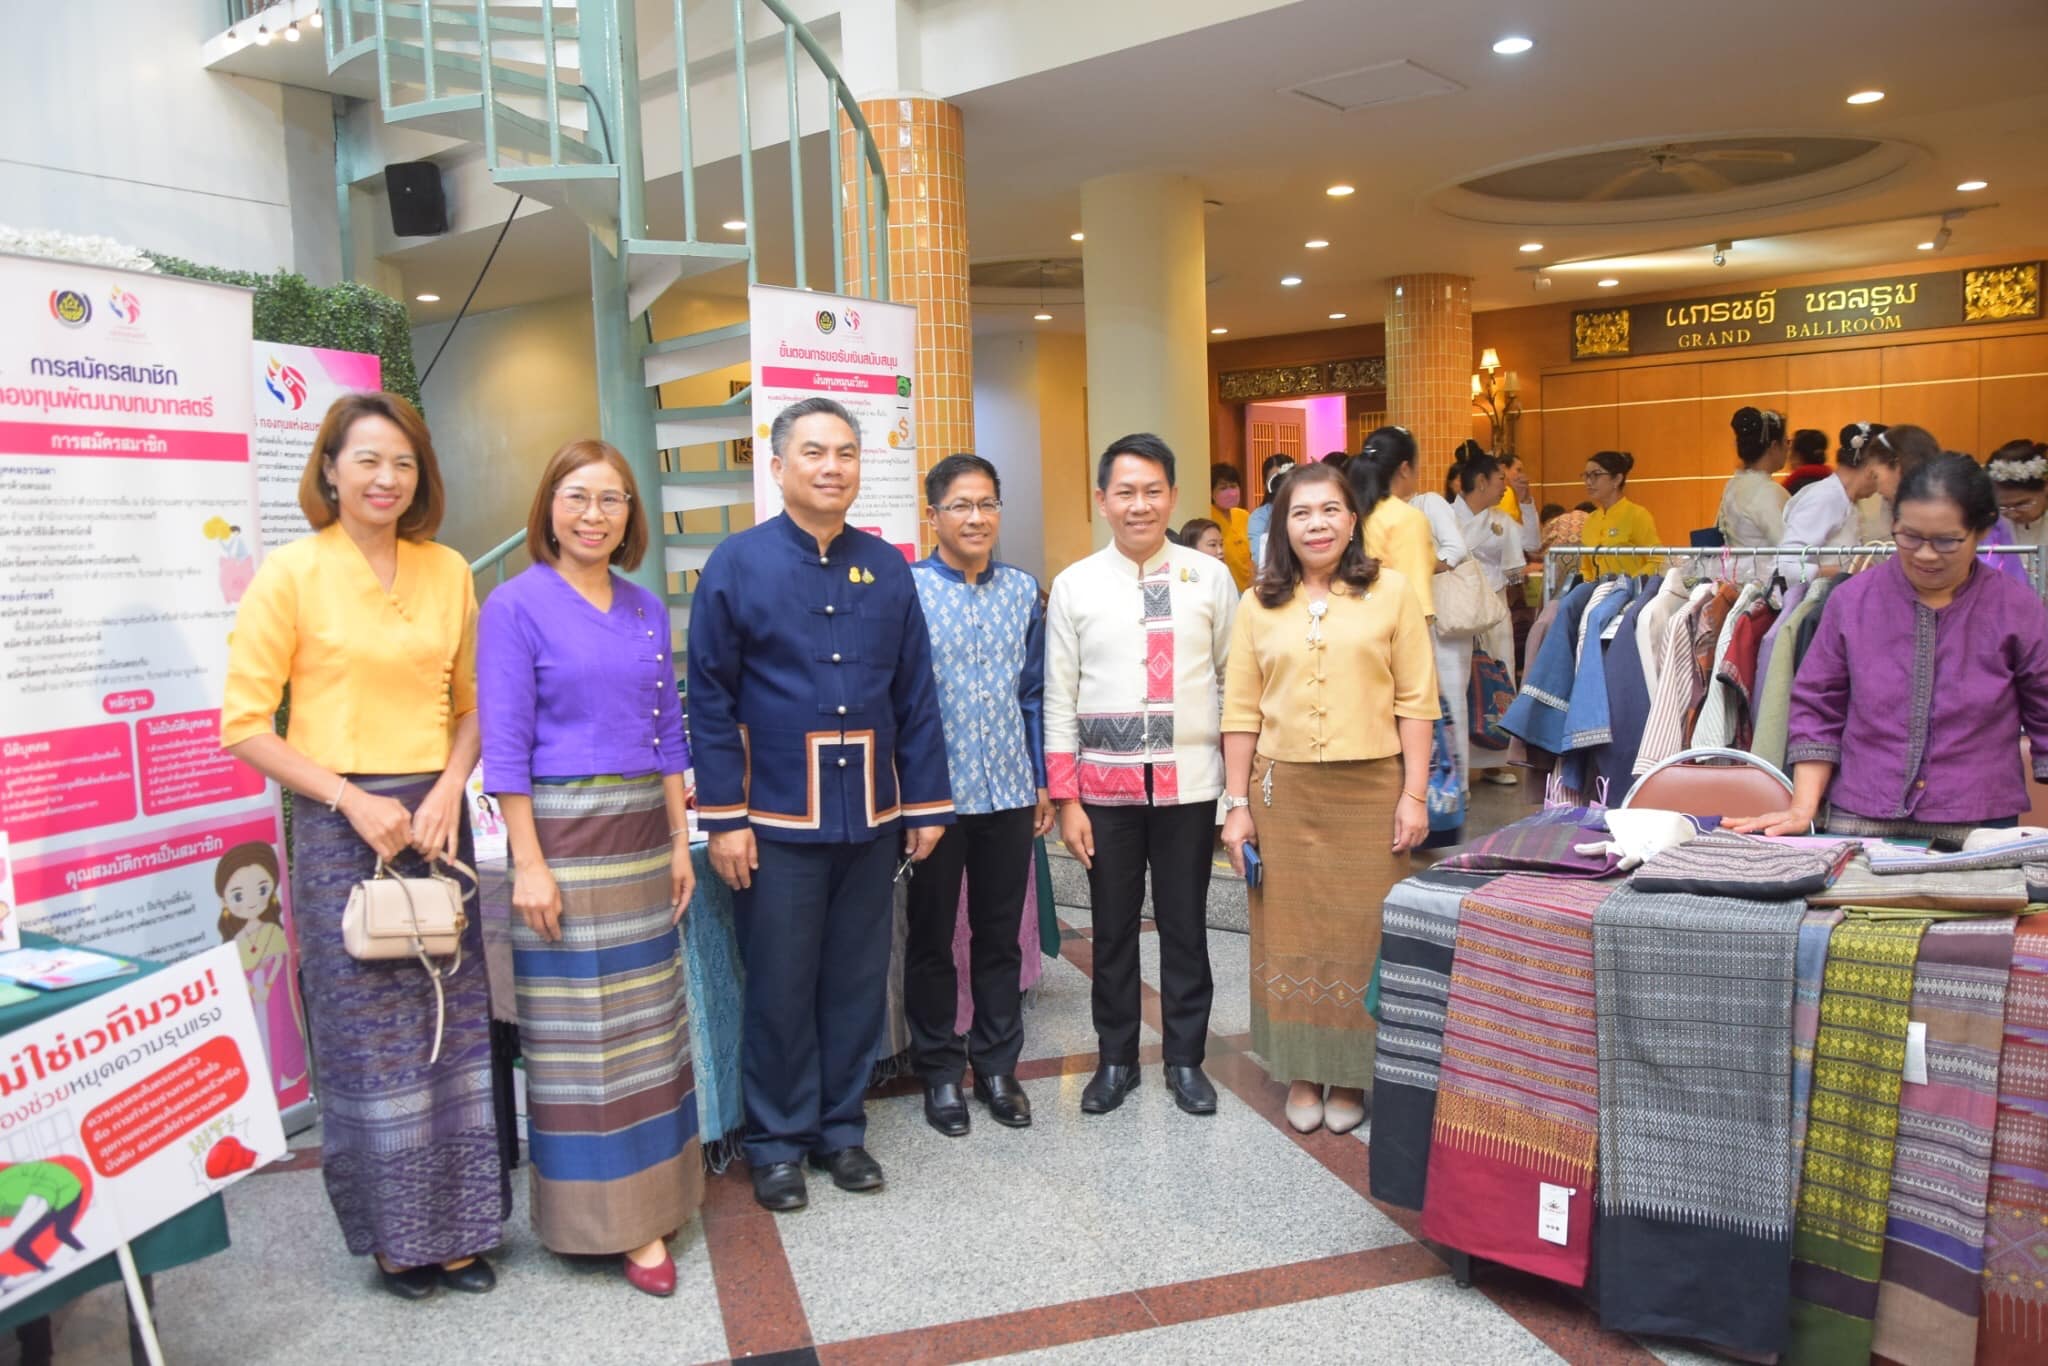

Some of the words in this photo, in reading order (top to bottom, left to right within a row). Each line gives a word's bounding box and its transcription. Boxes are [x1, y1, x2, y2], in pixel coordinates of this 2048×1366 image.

[1666, 289, 1777, 326] แกรนด์
[1806, 282, 1918, 316] บอลรูม
[1679, 329, 1751, 348] GRAND
[1786, 315, 1903, 339] BALLROOM
[31, 356, 179, 386] การสมัครสมาชิก
[51, 431, 168, 453] การสมัครสมาชิก
[66, 836, 223, 890] คุณสมบัติการเป็นสมาชิก
